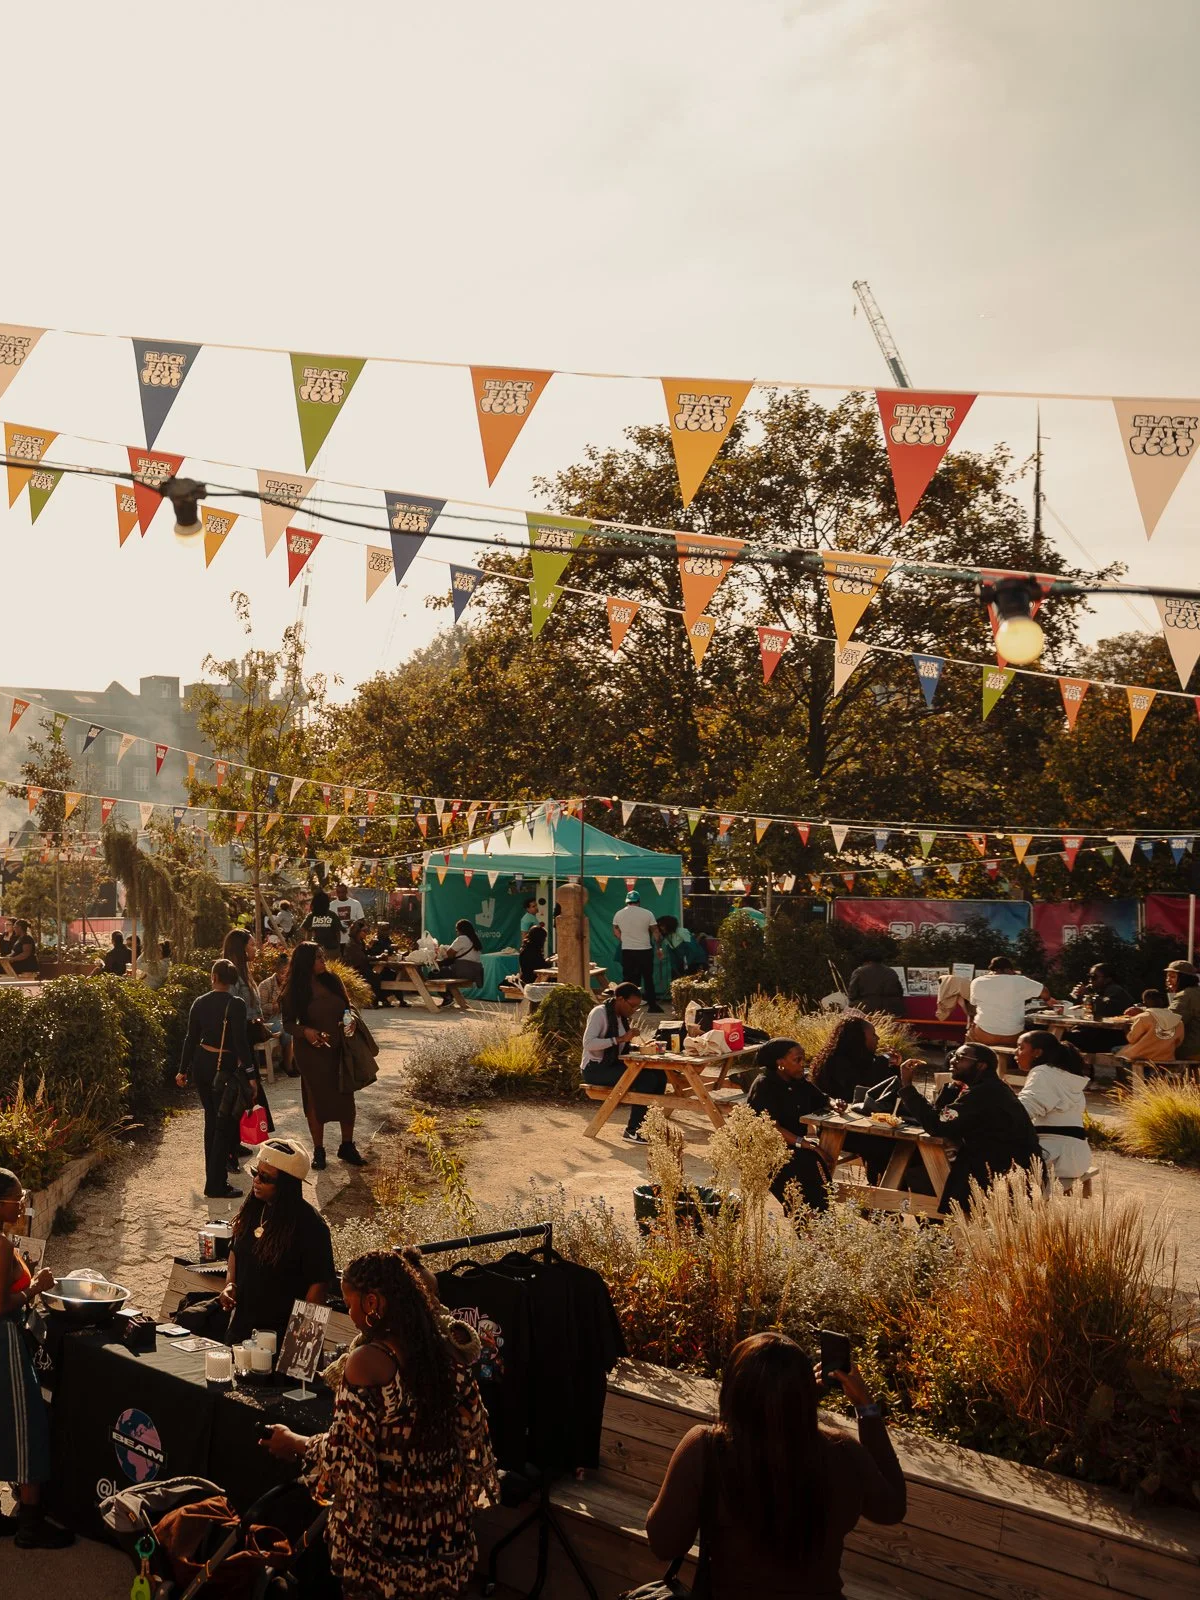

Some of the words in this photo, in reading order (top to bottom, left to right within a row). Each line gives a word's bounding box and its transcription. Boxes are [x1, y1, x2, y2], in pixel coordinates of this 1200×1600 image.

[144, 352, 186, 366] BLACK
[148, 363, 180, 373] EATS
[303, 367, 348, 382] BLACK
[307, 378, 341, 389] EATS
[484, 379, 534, 393] BLACK
[488, 390, 526, 400] EATS
[678, 393, 732, 408] BLACK
[683, 405, 724, 416] EATS
[894, 404, 956, 420] BLACK
[674, 412, 727, 432] FEST
[898, 417, 947, 428] EATS
[1134, 415, 1199, 430] BLACK
[12, 434, 45, 445] BLACK
[889, 424, 950, 446] FEST
[1139, 427, 1190, 438] EATS
[1130, 436, 1194, 456] FEST
[138, 458, 171, 471] BLACK
[266, 480, 302, 493] BLACK
[836, 564, 877, 578] BLACK
[1166, 598, 1200, 610] BLAC
[1165, 613, 1200, 630] FES
[112, 1432, 164, 1462] BEAM
